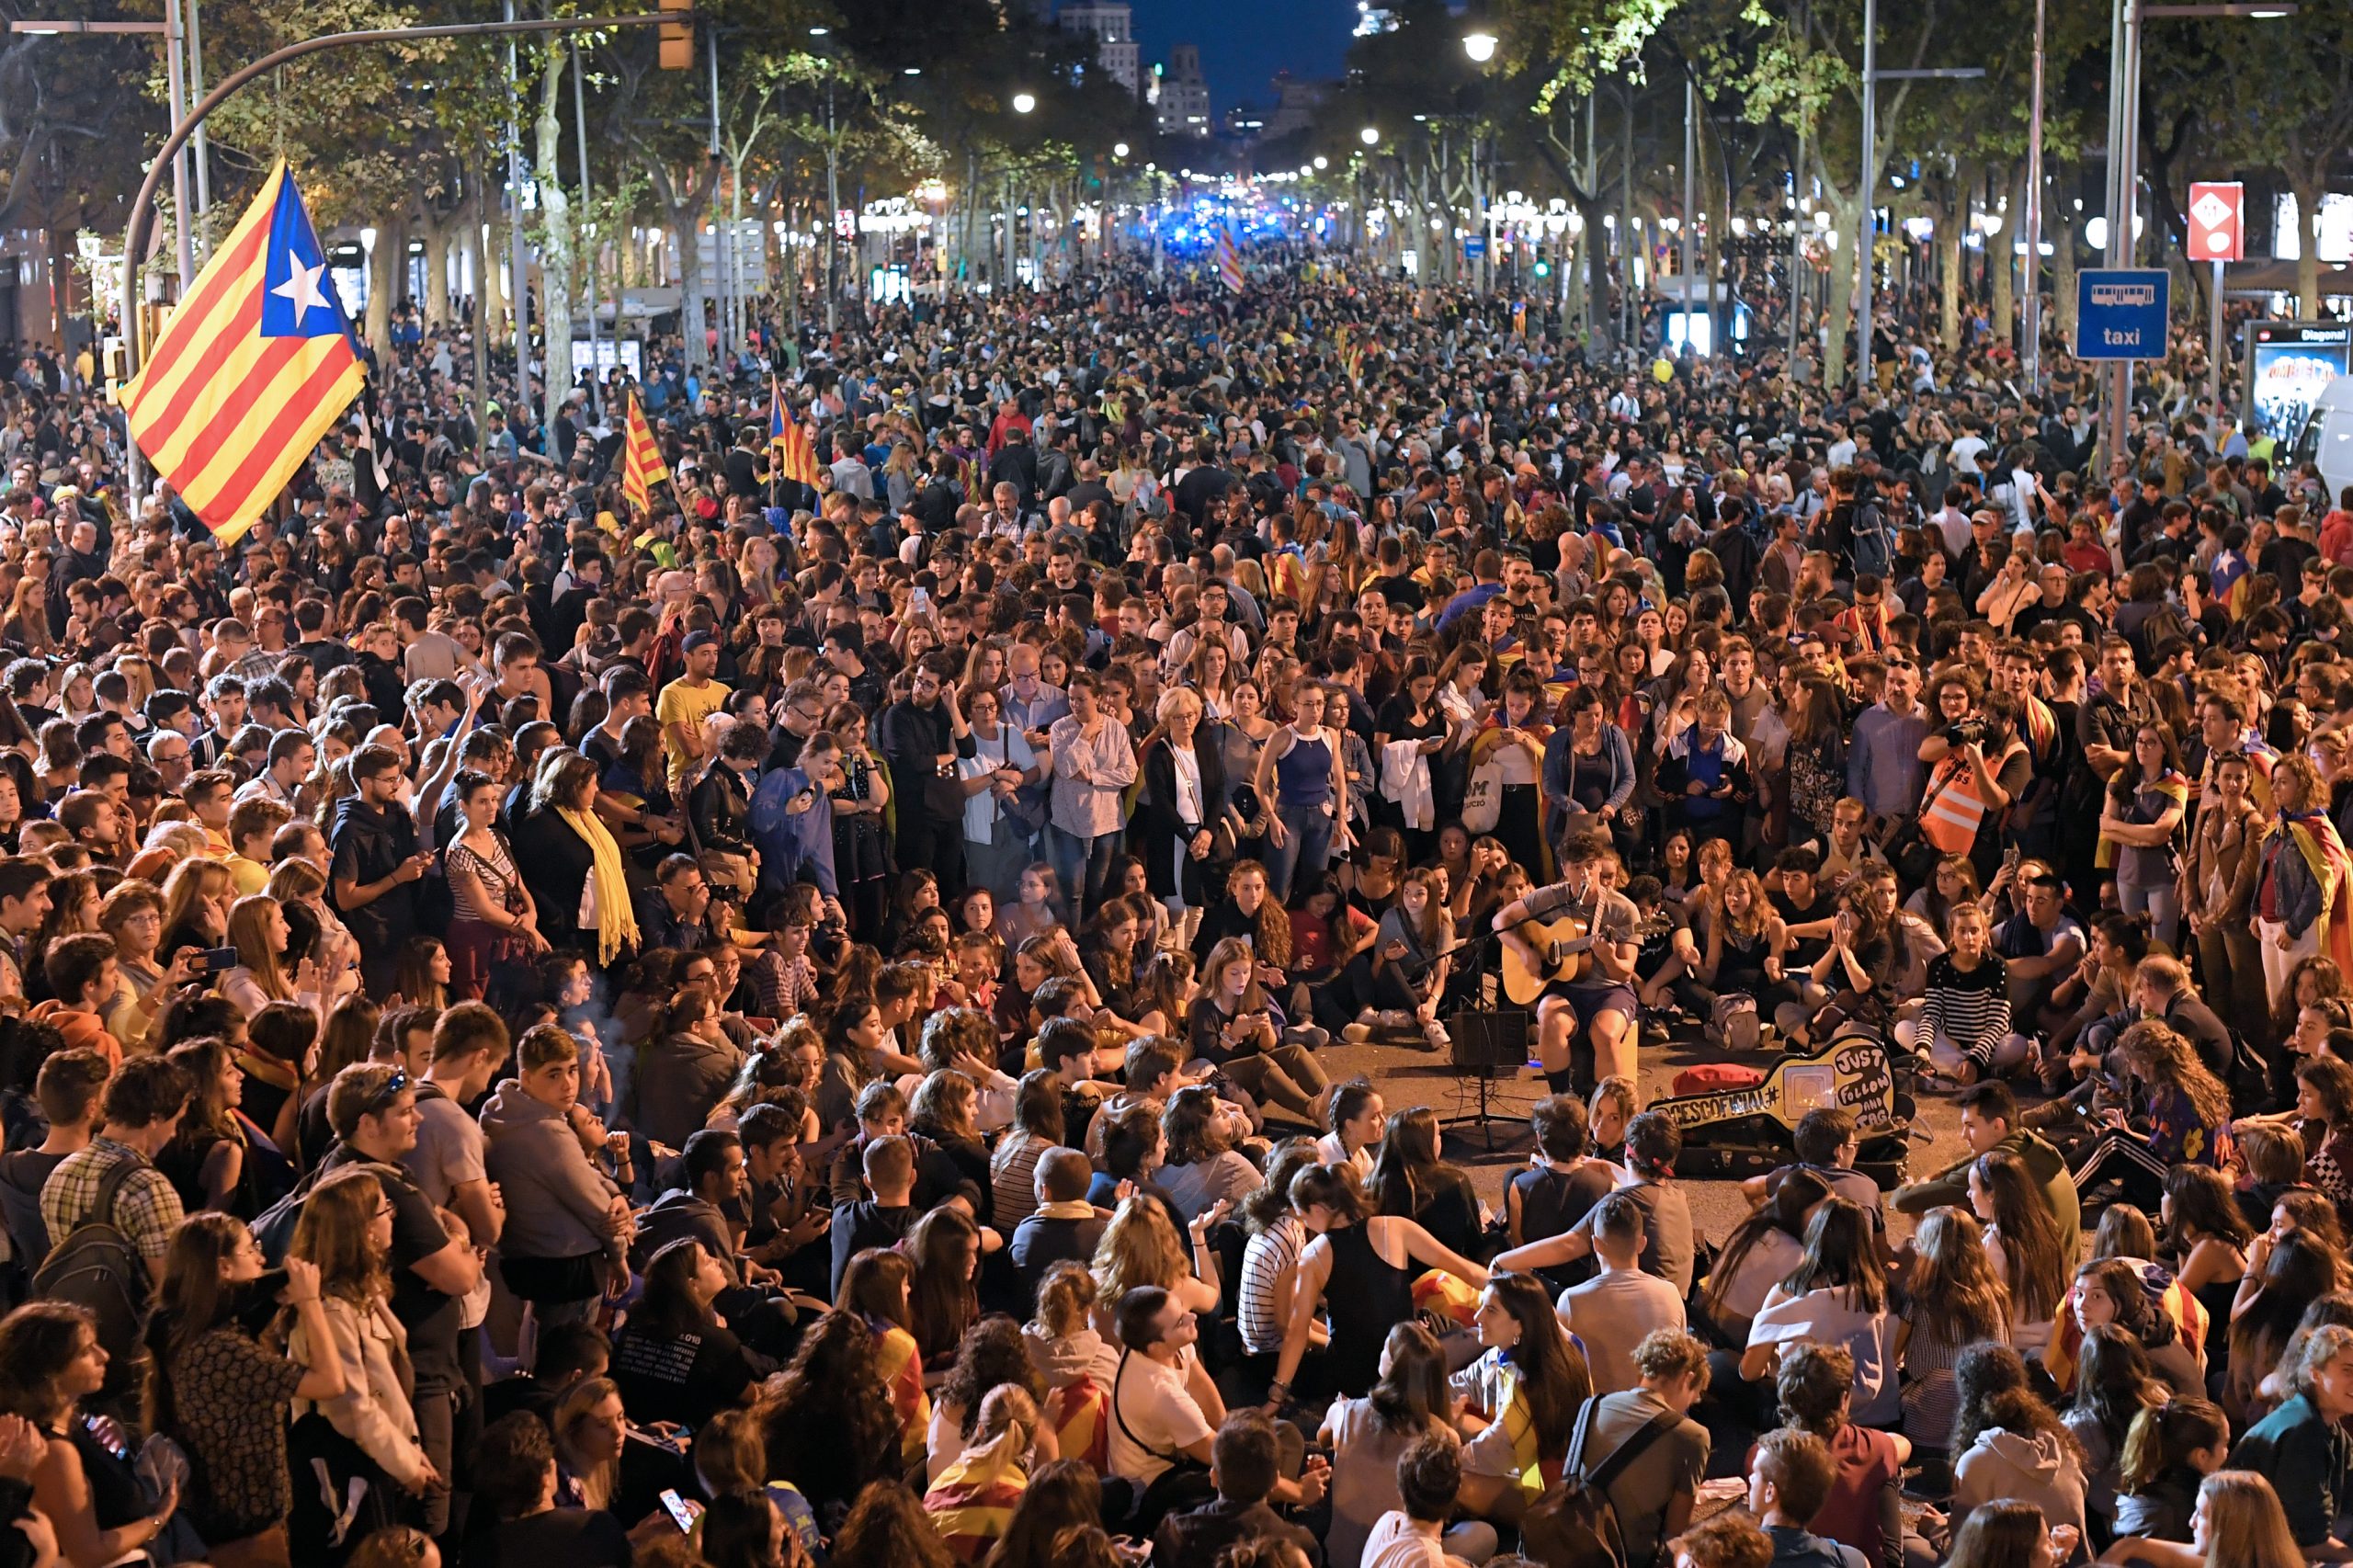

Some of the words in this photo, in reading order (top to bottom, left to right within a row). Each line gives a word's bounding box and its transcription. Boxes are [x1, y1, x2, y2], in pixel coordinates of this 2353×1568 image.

[2103, 327, 2141, 346] taxi
[2301, 329, 2347, 342] Diagonal
[1836, 1049, 1883, 1074] JUST
[1840, 1074, 1890, 1105] FOLLOW
[1863, 1096, 1883, 1112] AND
[1855, 1108, 1888, 1130] TAG
